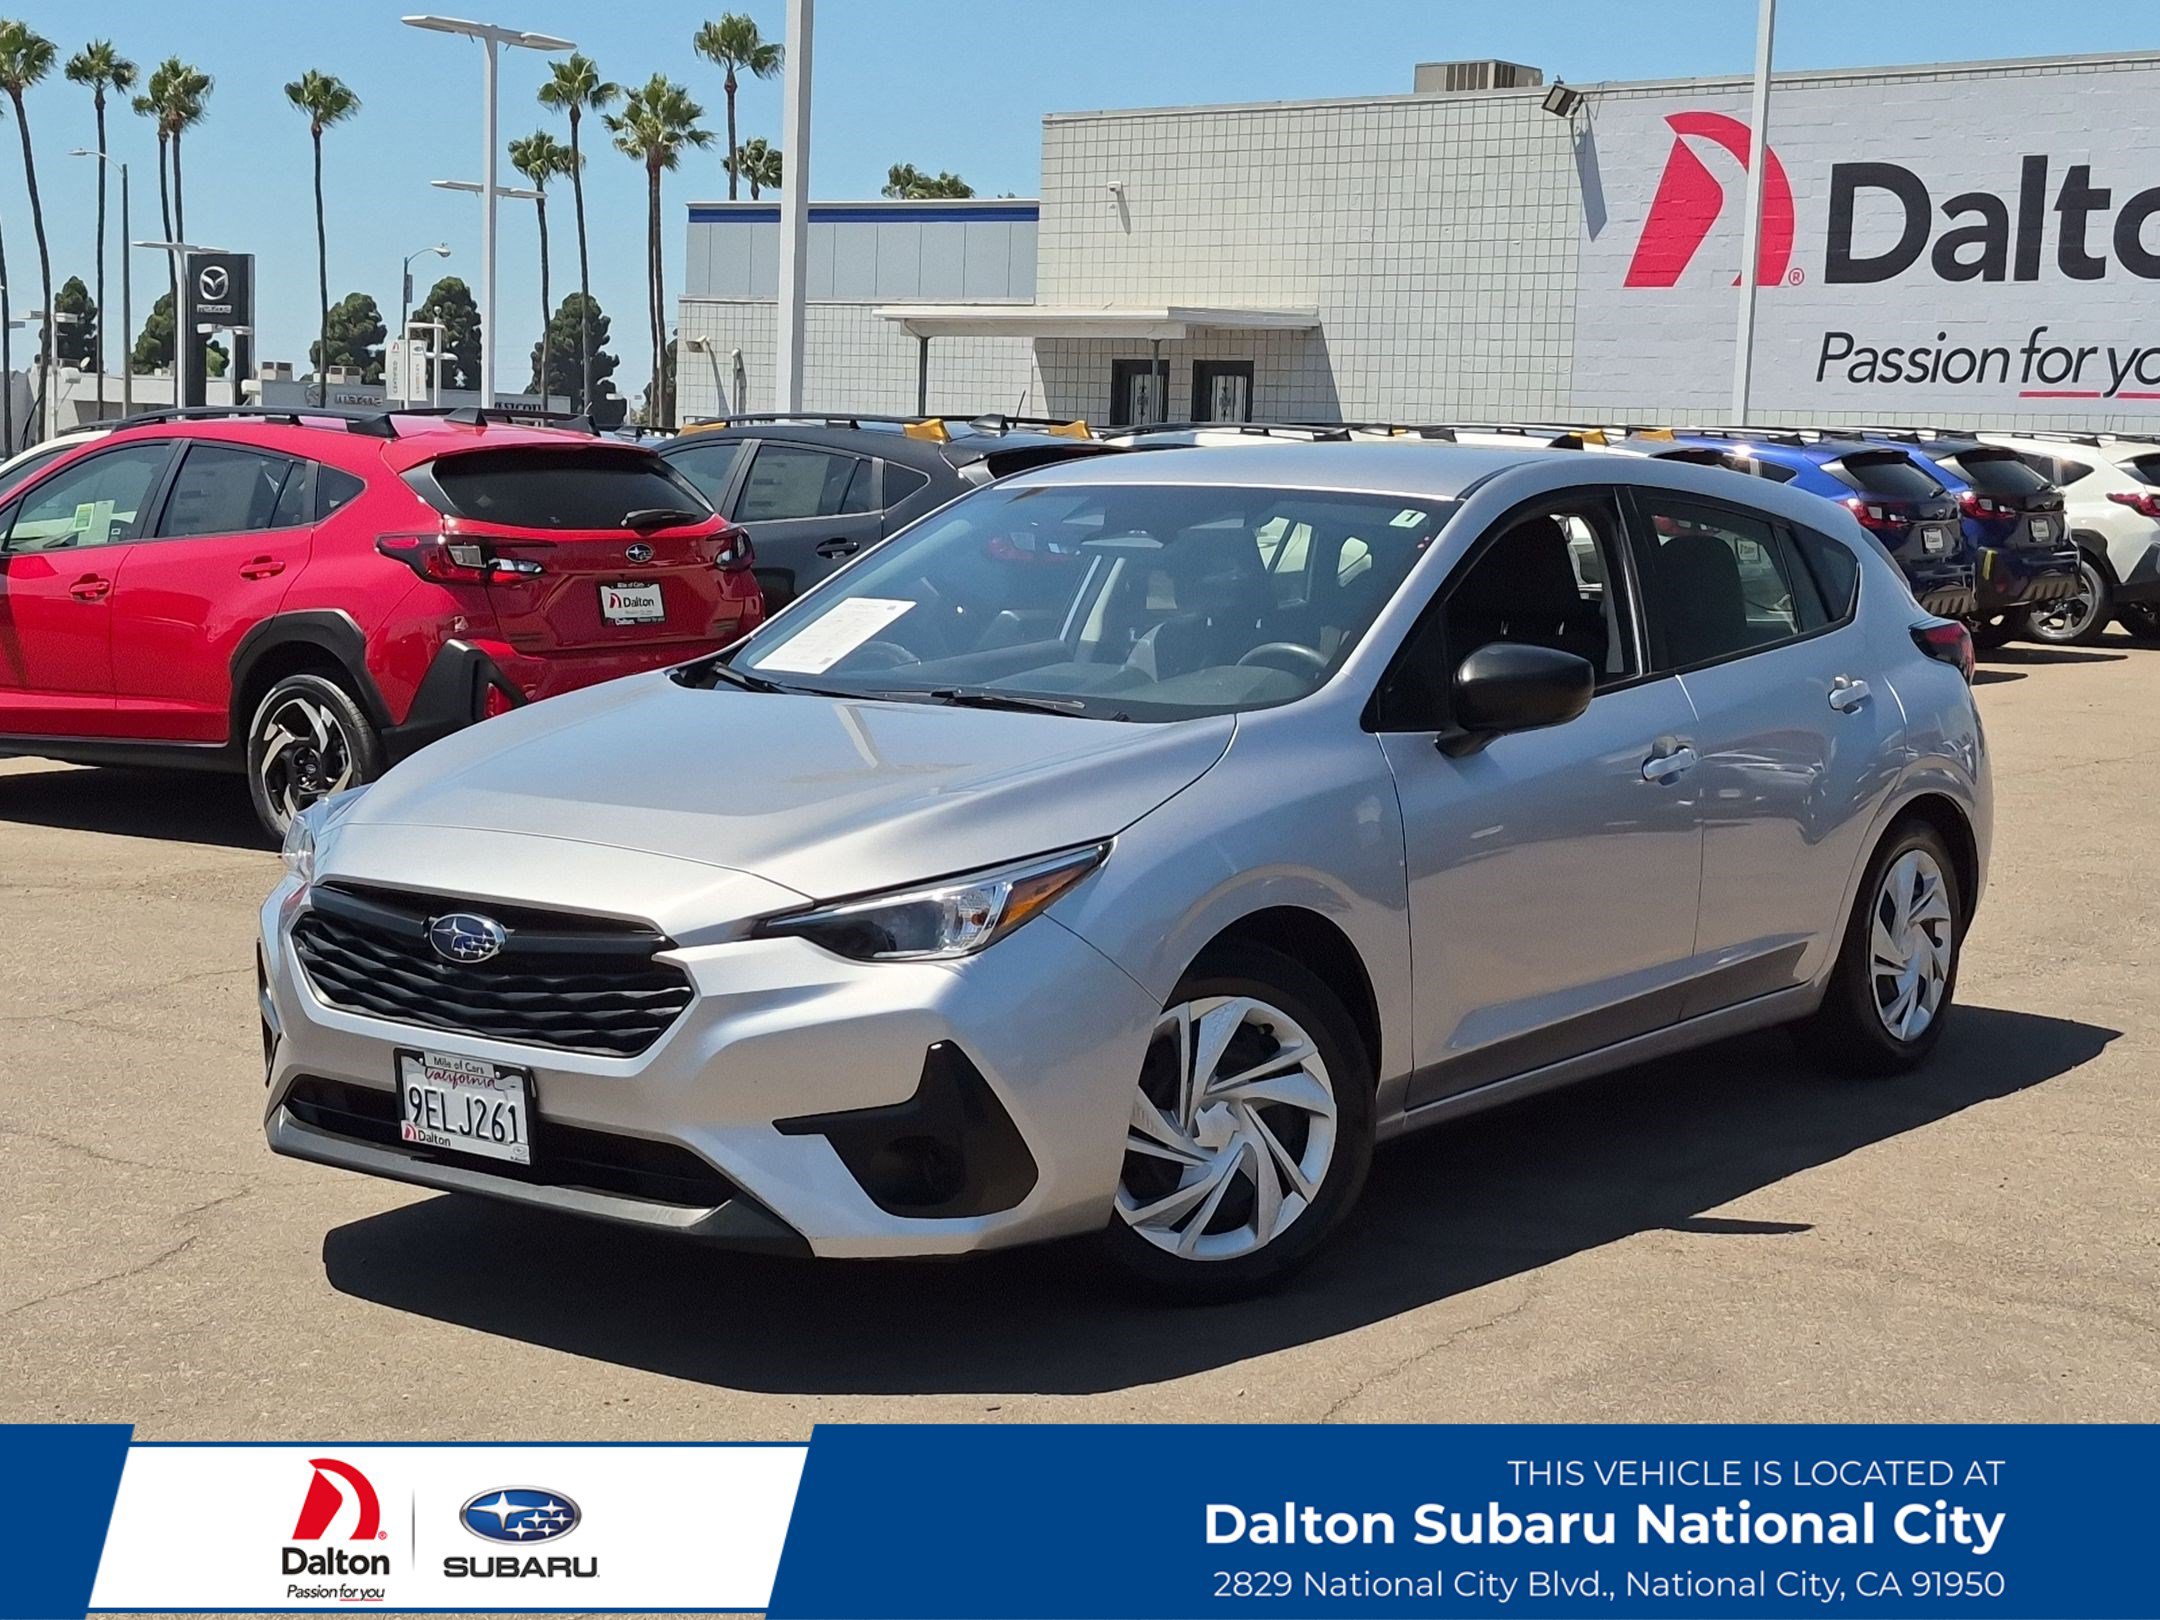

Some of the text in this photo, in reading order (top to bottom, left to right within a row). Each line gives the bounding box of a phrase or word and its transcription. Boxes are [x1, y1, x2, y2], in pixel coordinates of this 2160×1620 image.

[1816, 331, 2010, 385] Passion
[2019, 326, 2099, 384] for
[623, 596, 654, 607] Dalton
[433, 1056, 485, 1075] Mile of Cars
[408, 1086, 519, 1145] 9ELJ261
[418, 1130, 451, 1147] Dalton
